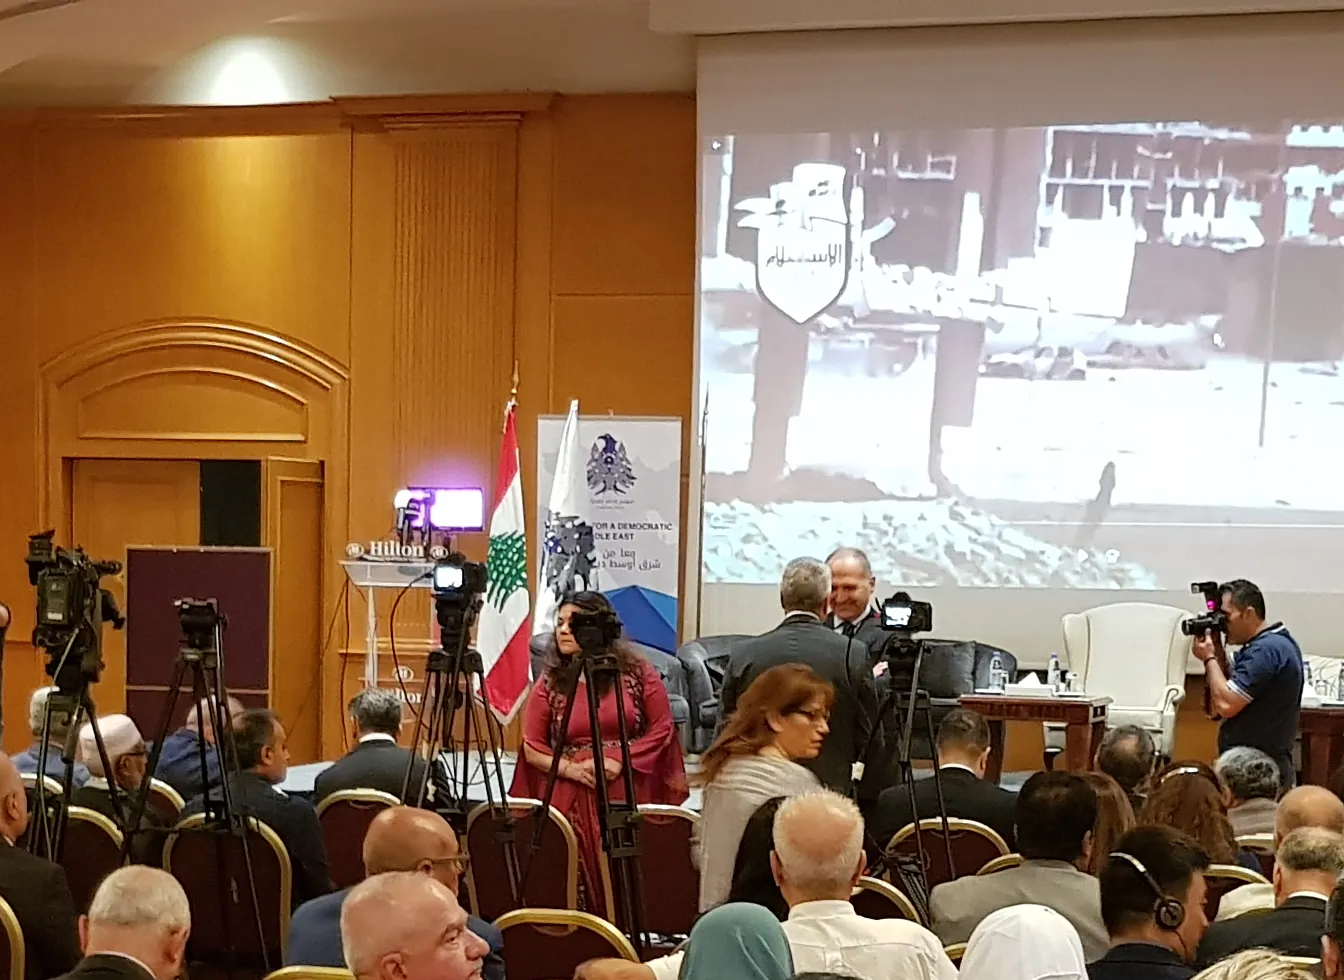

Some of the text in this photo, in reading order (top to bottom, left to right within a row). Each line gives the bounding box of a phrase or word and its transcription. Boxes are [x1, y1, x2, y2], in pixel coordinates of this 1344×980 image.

[610, 522, 616, 530] A
[617, 522, 673, 531] DEMOCRATIC
[612, 532, 634, 540] EAST
[370, 540, 424, 557] Hilton
